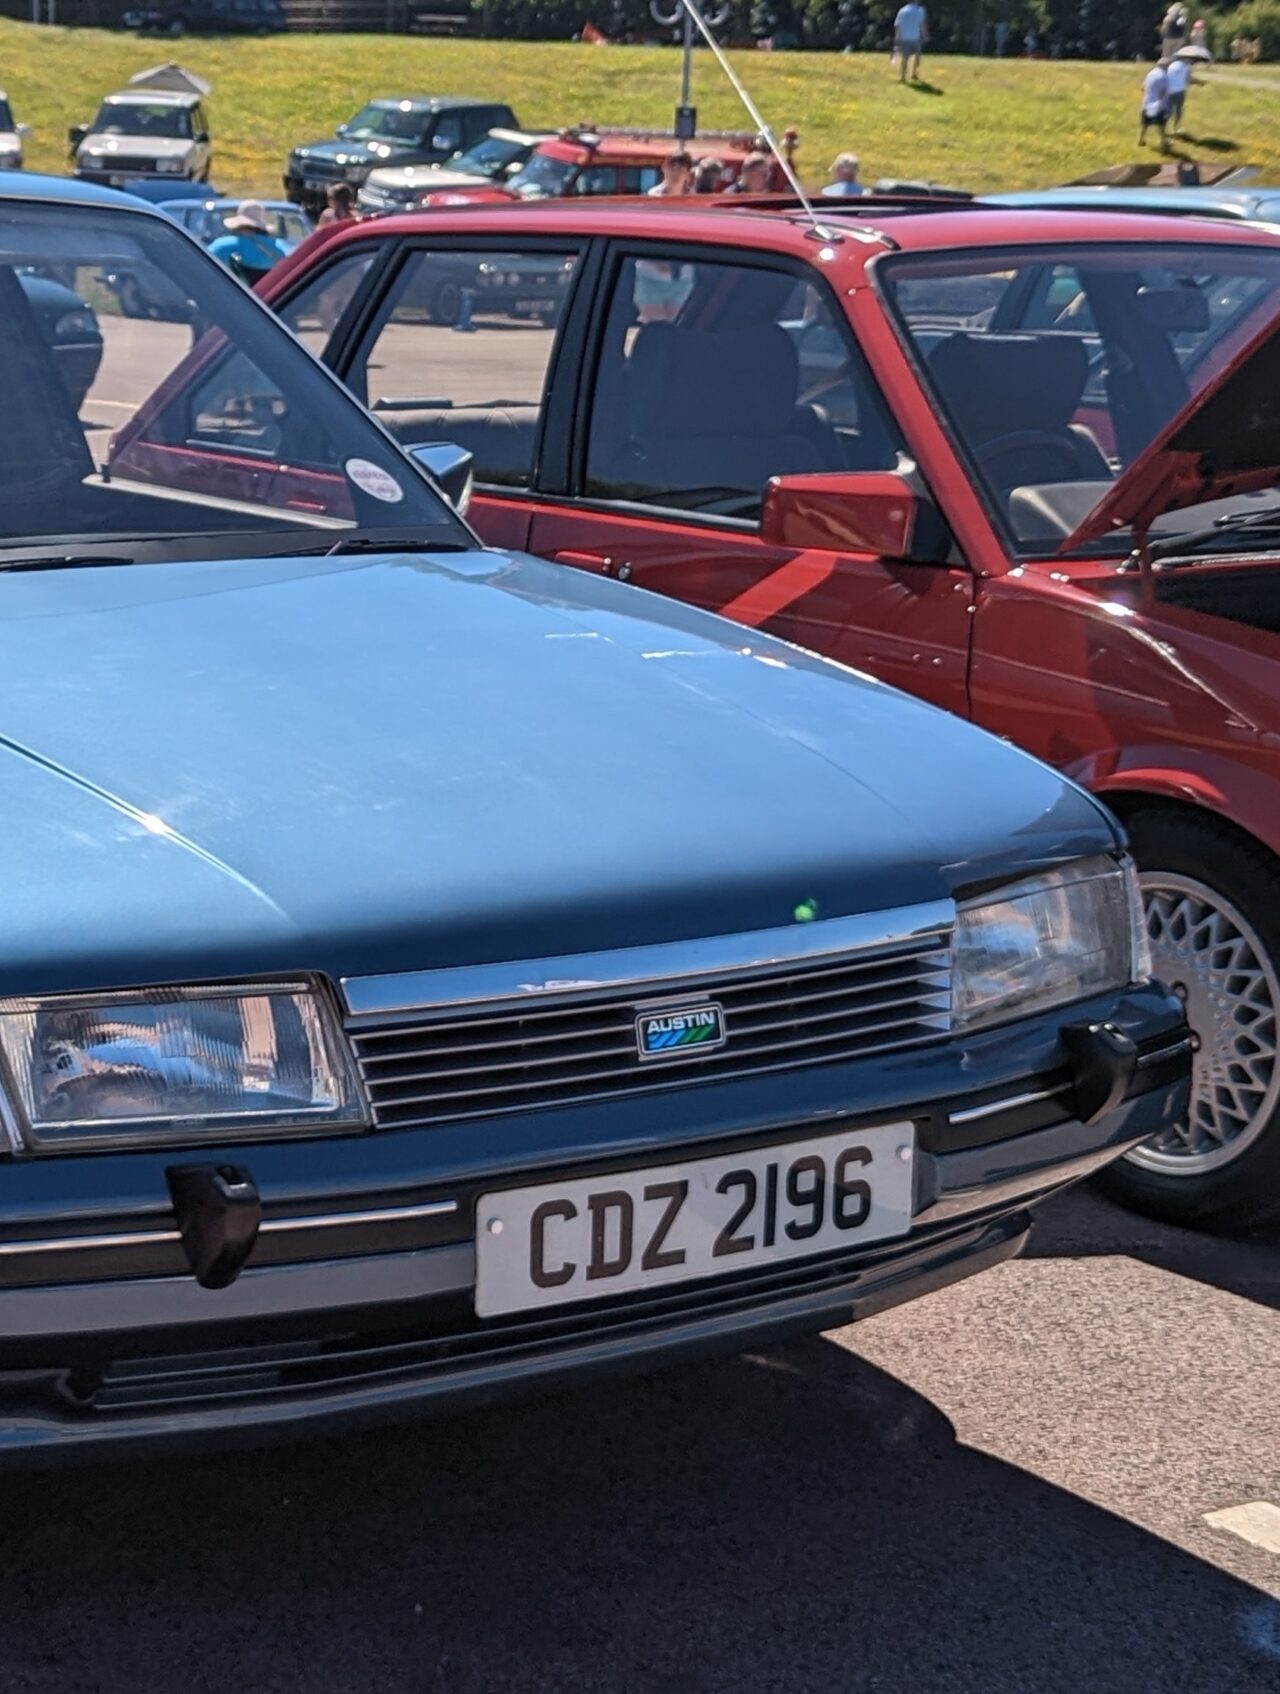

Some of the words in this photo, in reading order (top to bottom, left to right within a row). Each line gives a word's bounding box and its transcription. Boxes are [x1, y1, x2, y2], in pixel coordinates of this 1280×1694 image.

[647, 1011, 715, 1034] AUSTIN
[529, 1179, 689, 1288] CDZ
[711, 1145, 873, 1258] 2196
